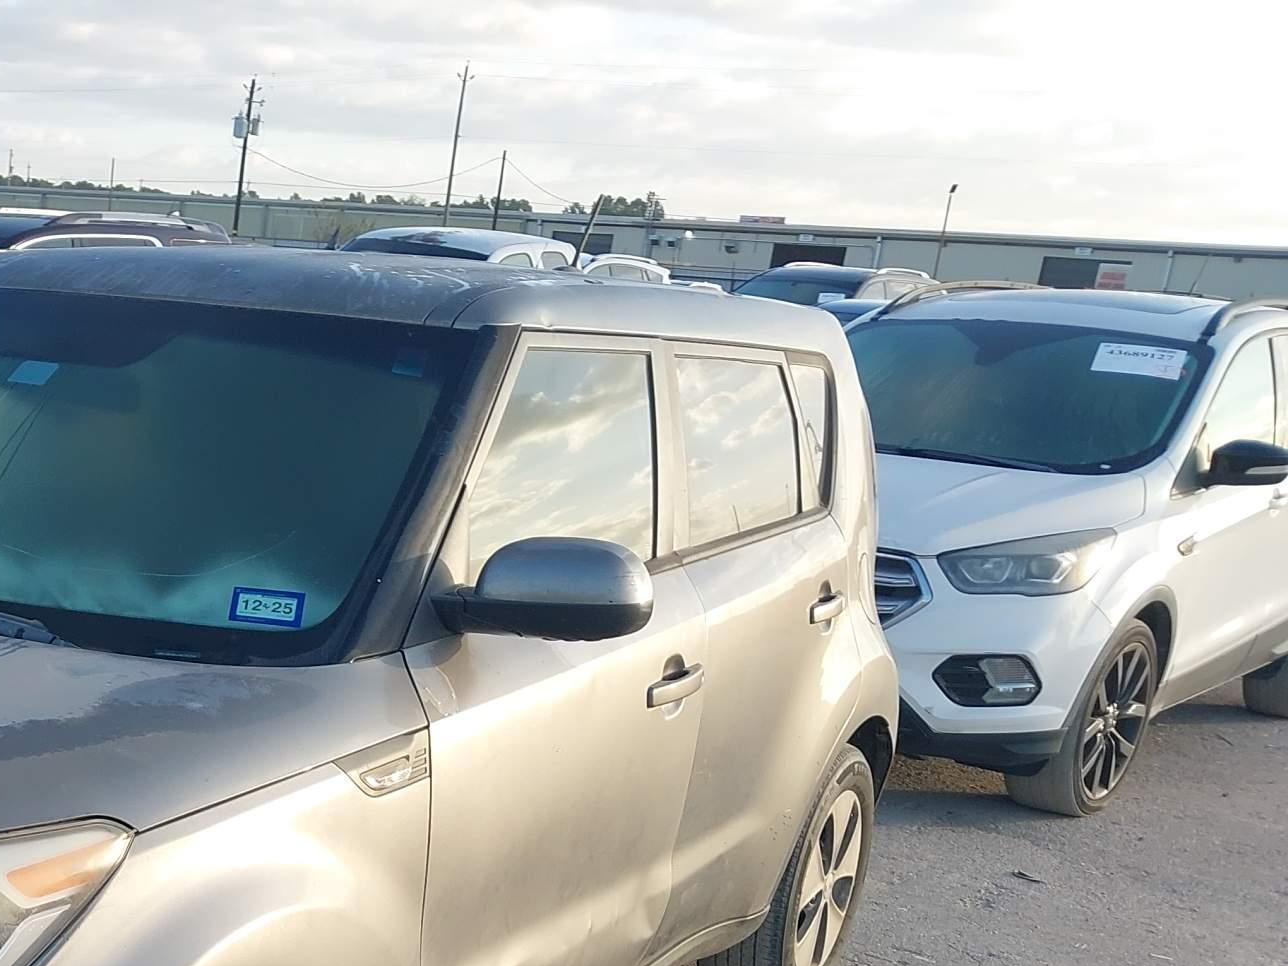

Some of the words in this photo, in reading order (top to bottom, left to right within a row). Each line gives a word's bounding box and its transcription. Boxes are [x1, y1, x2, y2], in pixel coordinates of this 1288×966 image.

[1105, 348, 1175, 361] 43689127
[241, 598, 263, 611] 12
[271, 601, 294, 615] 25
